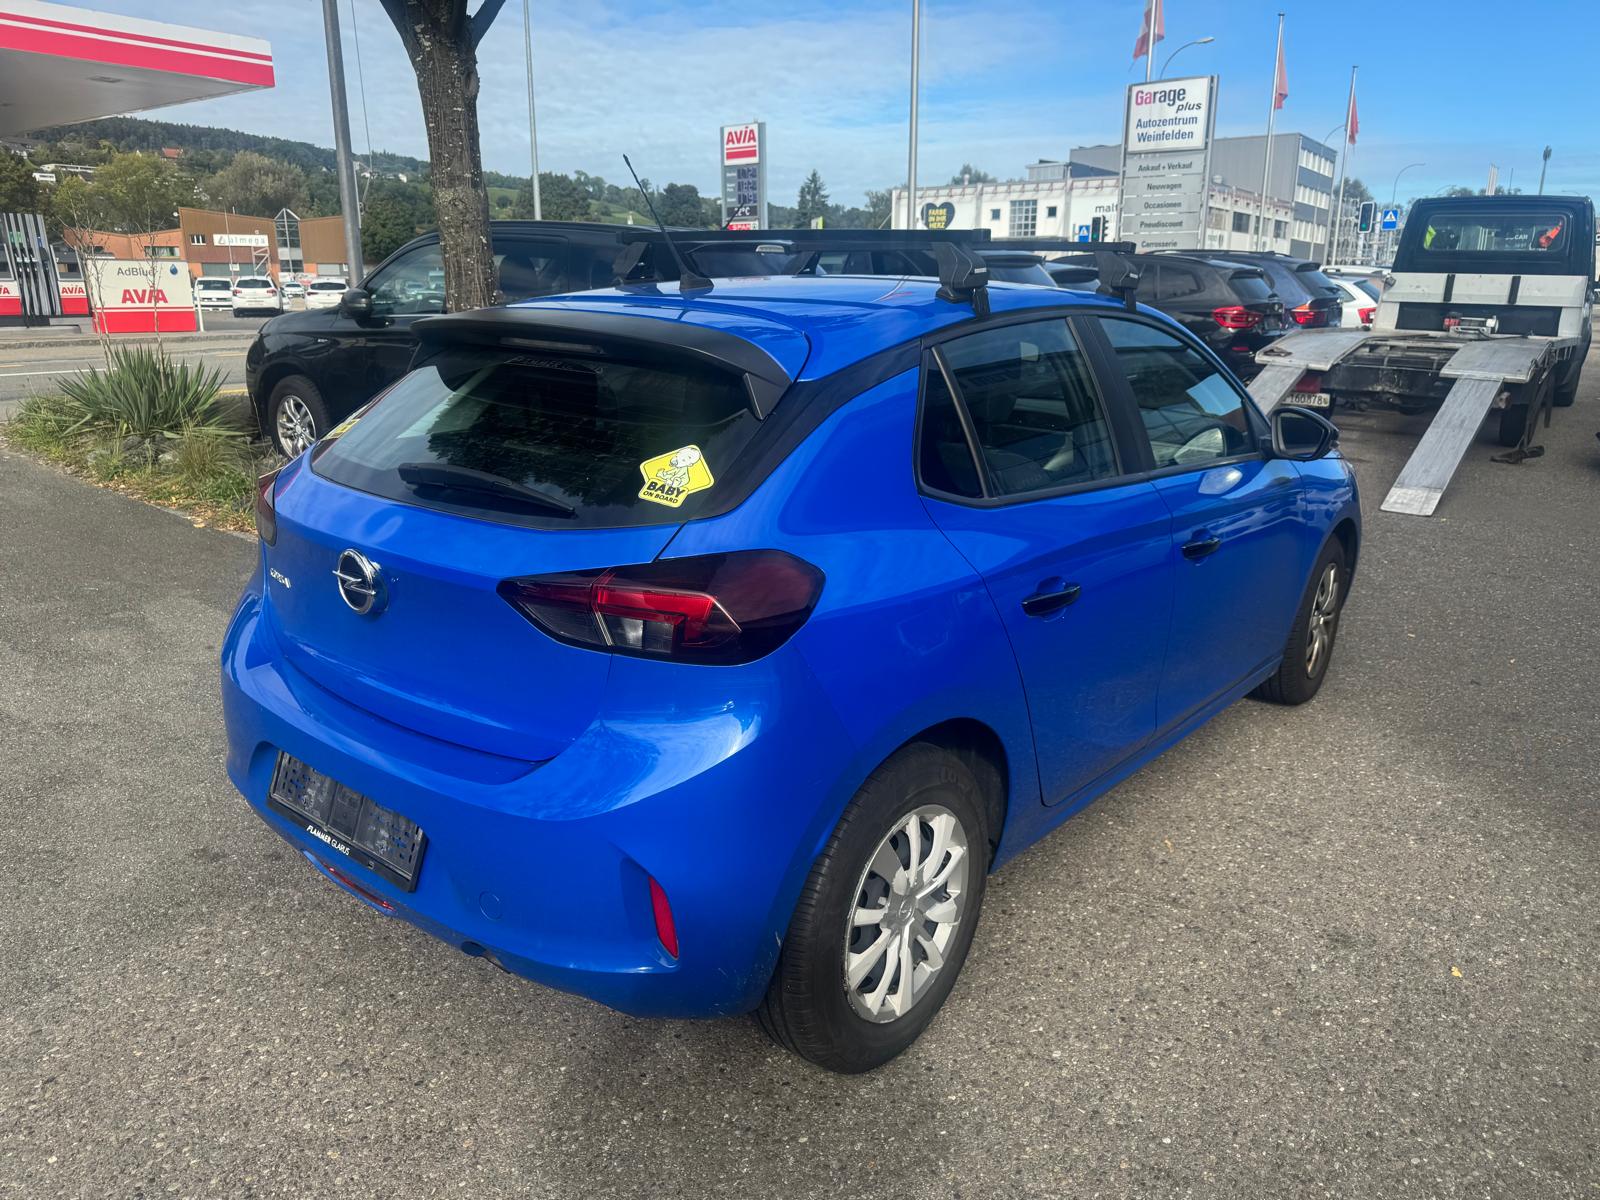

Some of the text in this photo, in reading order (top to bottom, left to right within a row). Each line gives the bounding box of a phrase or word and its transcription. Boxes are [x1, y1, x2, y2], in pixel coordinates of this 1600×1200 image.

[1135, 87, 1186, 107] Garage
[1176, 102, 1202, 113] plus
[1136, 116, 1198, 129] Autozentrum
[726, 126, 756, 145] AVIA
[1137, 130, 1194, 143] Weinfelden
[1138, 163, 1161, 172] Ankauf
[1167, 161, 1192, 170] Verkauf
[1147, 183, 1182, 191] Neuwagen
[1140, 220, 1183, 228] Pneudiscount
[1141, 240, 1178, 248] Carrosserie
[117, 266, 154, 277] AdBlue
[61, 284, 85, 295] AVIA
[121, 286, 168, 304] AVIA
[647, 481, 685, 497] BABY
[655, 494, 678, 503] BOARD
[306, 824, 351, 856] FLAMMER GLARUS
